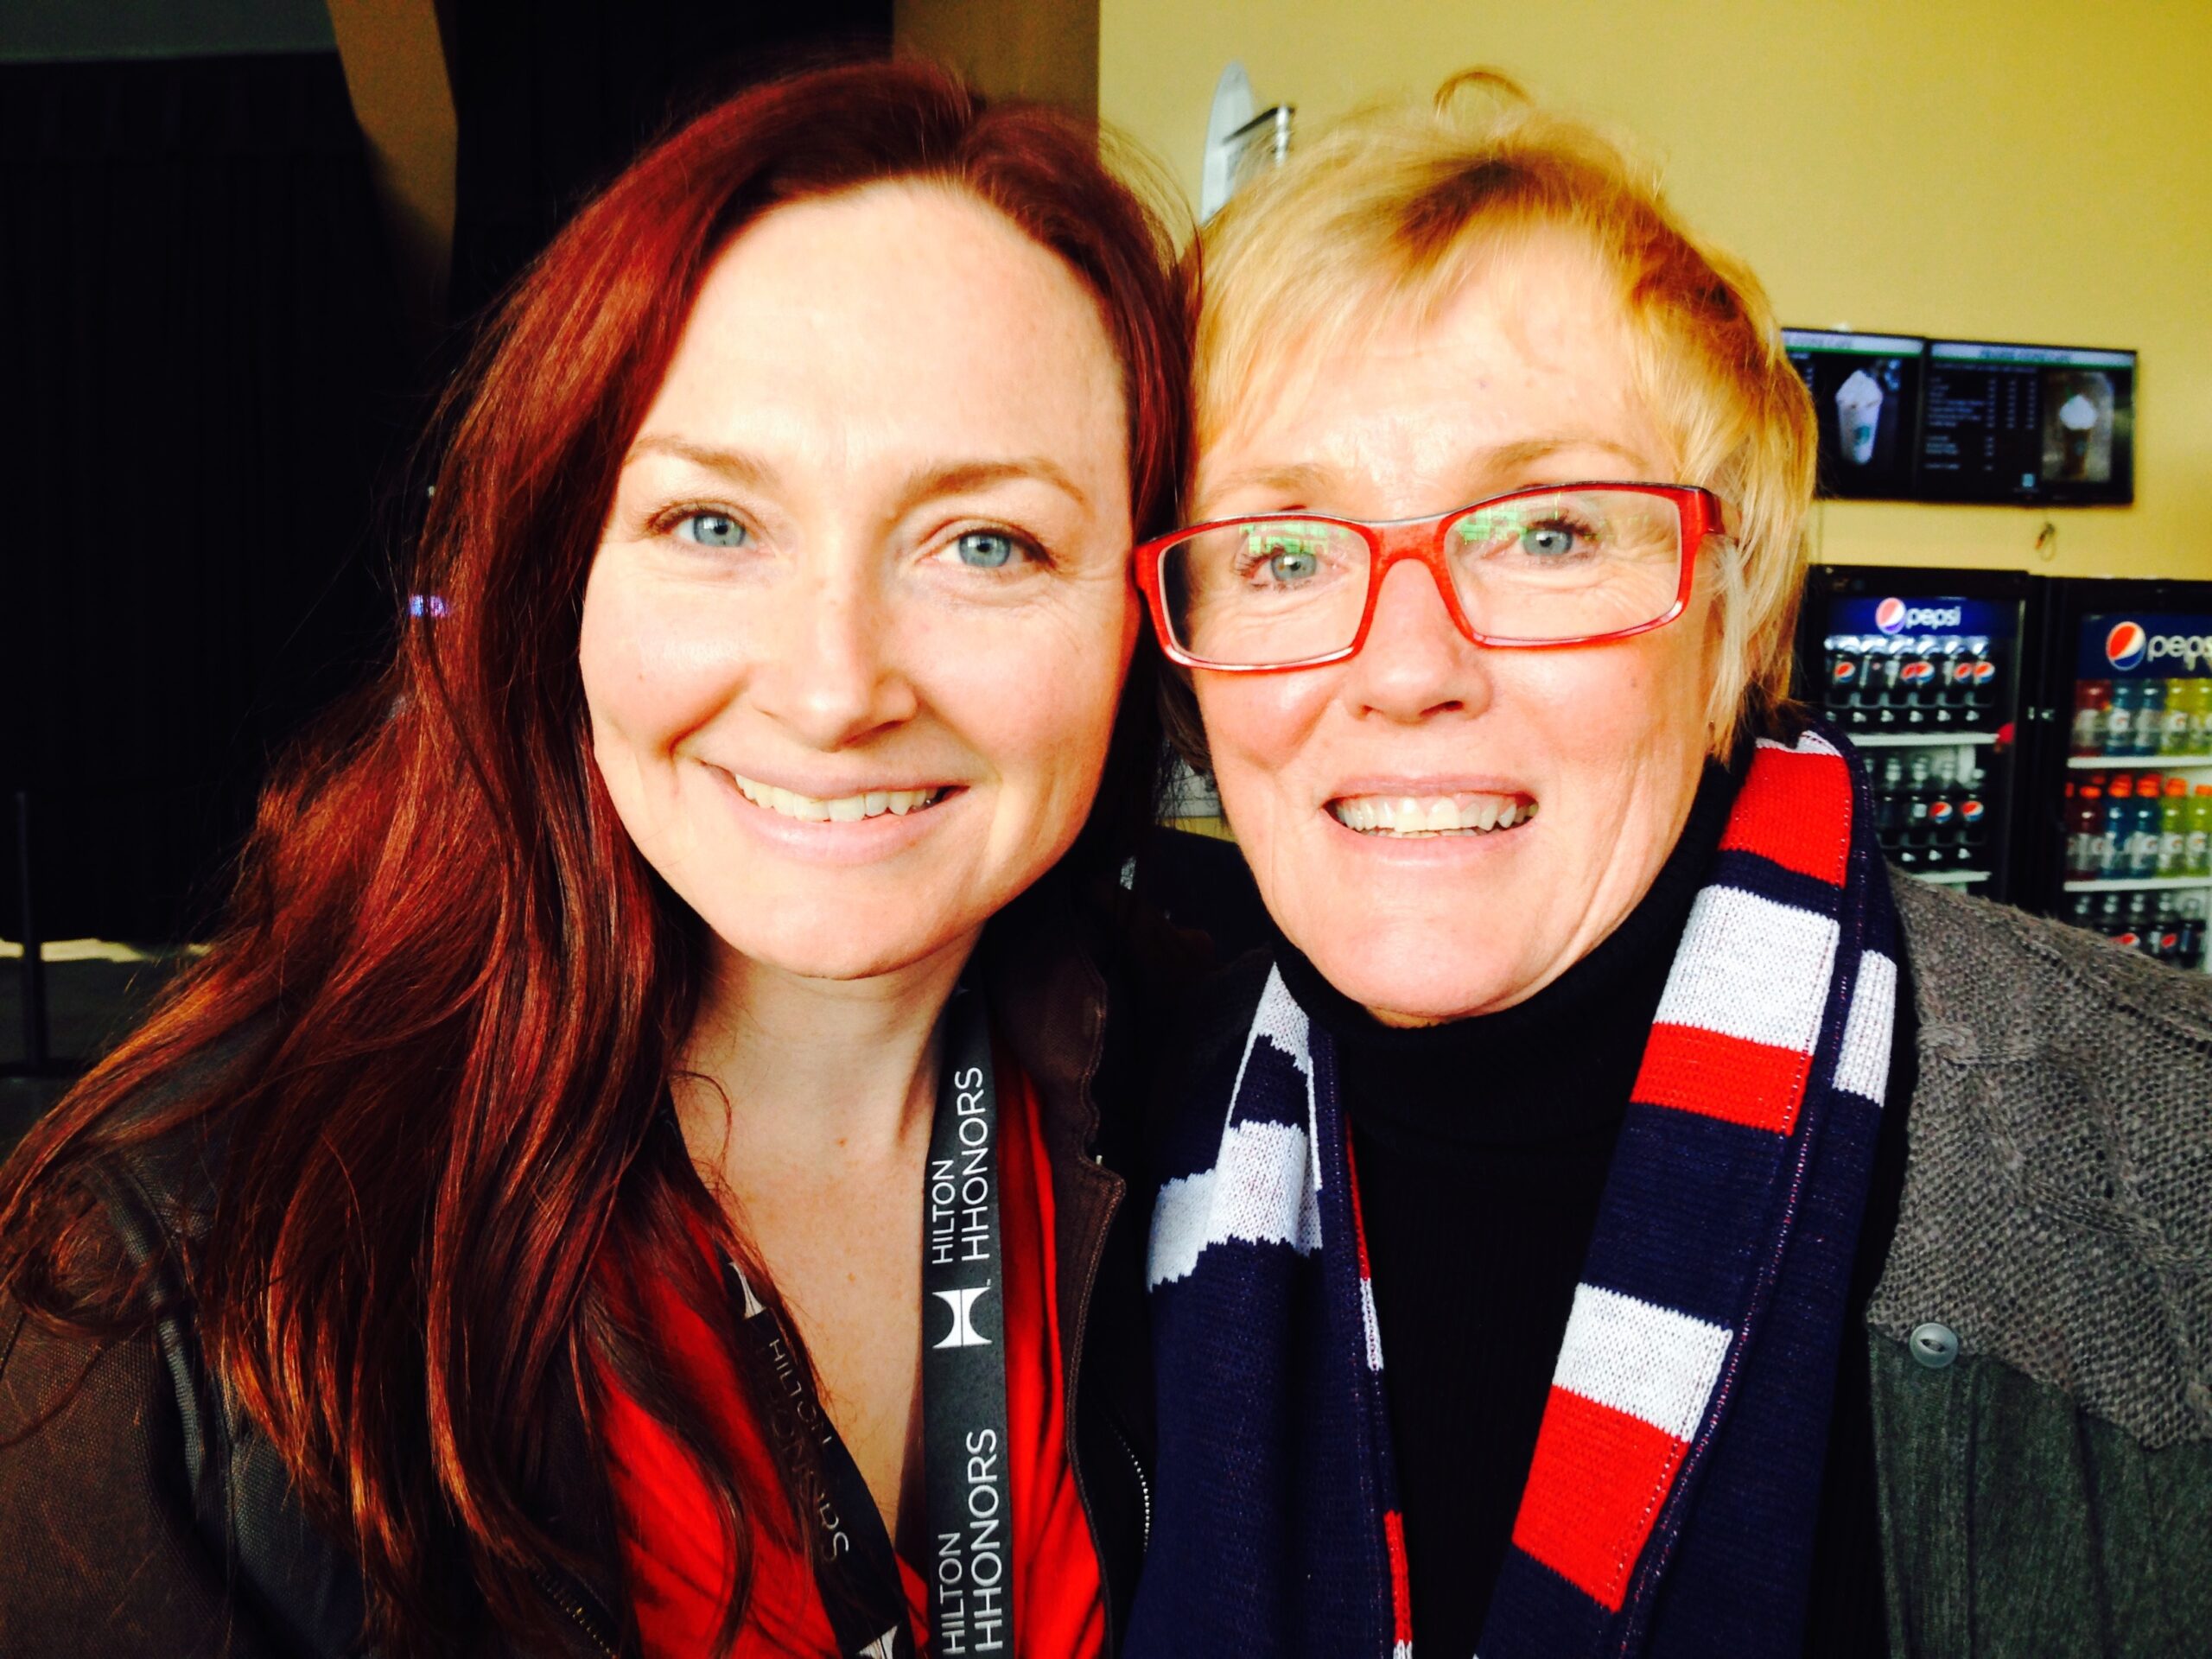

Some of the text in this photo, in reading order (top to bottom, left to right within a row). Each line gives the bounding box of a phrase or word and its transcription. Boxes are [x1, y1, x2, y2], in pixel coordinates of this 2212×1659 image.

[1906, 606, 1961, 629] pepsi
[931, 1160, 956, 1264] HILTON
[954, 1067, 990, 1262] HHONORS
[938, 1532, 966, 1655] HILTON
[965, 1428, 1003, 1652] HHONORS
